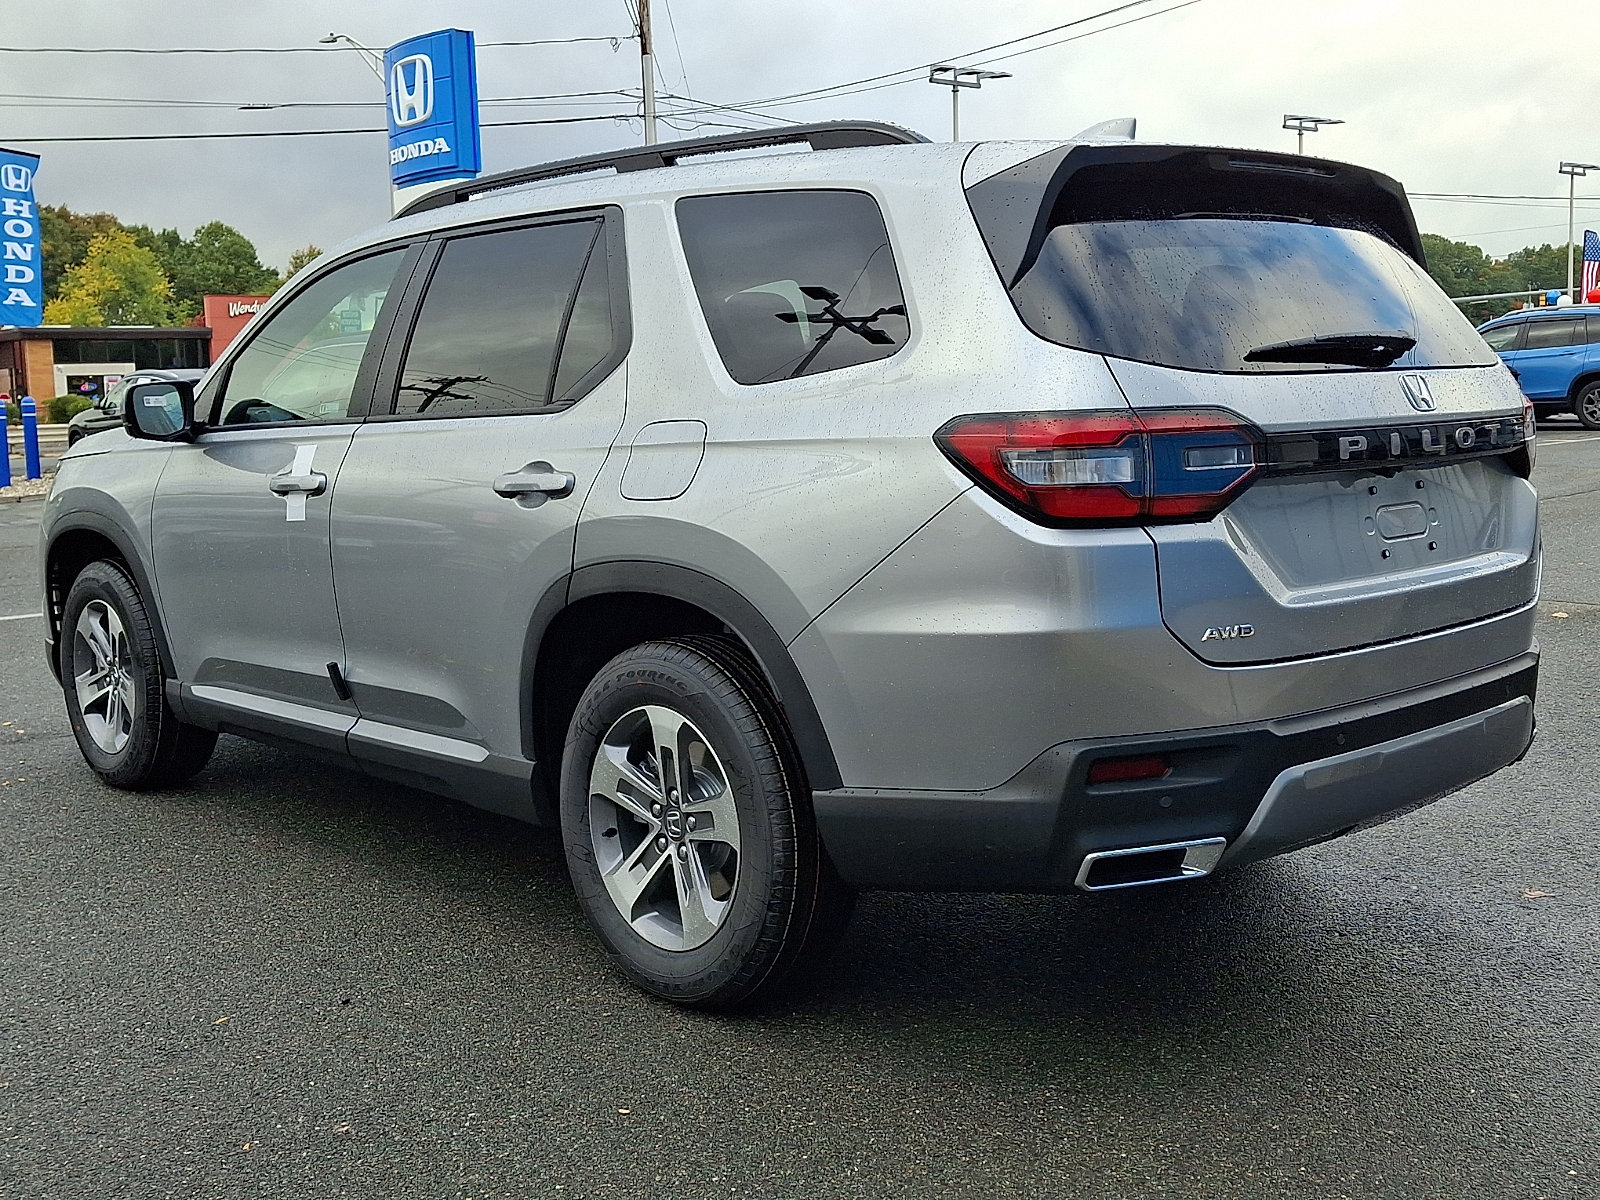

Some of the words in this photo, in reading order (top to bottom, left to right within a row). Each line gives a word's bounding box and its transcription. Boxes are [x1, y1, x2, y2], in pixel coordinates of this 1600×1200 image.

[389, 137, 451, 165] HONDA
[2, 198, 37, 307] HONDA
[1338, 423, 1501, 460] PILOT
[1200, 624, 1255, 642] AWD
[615, 668, 689, 692] TOURING
